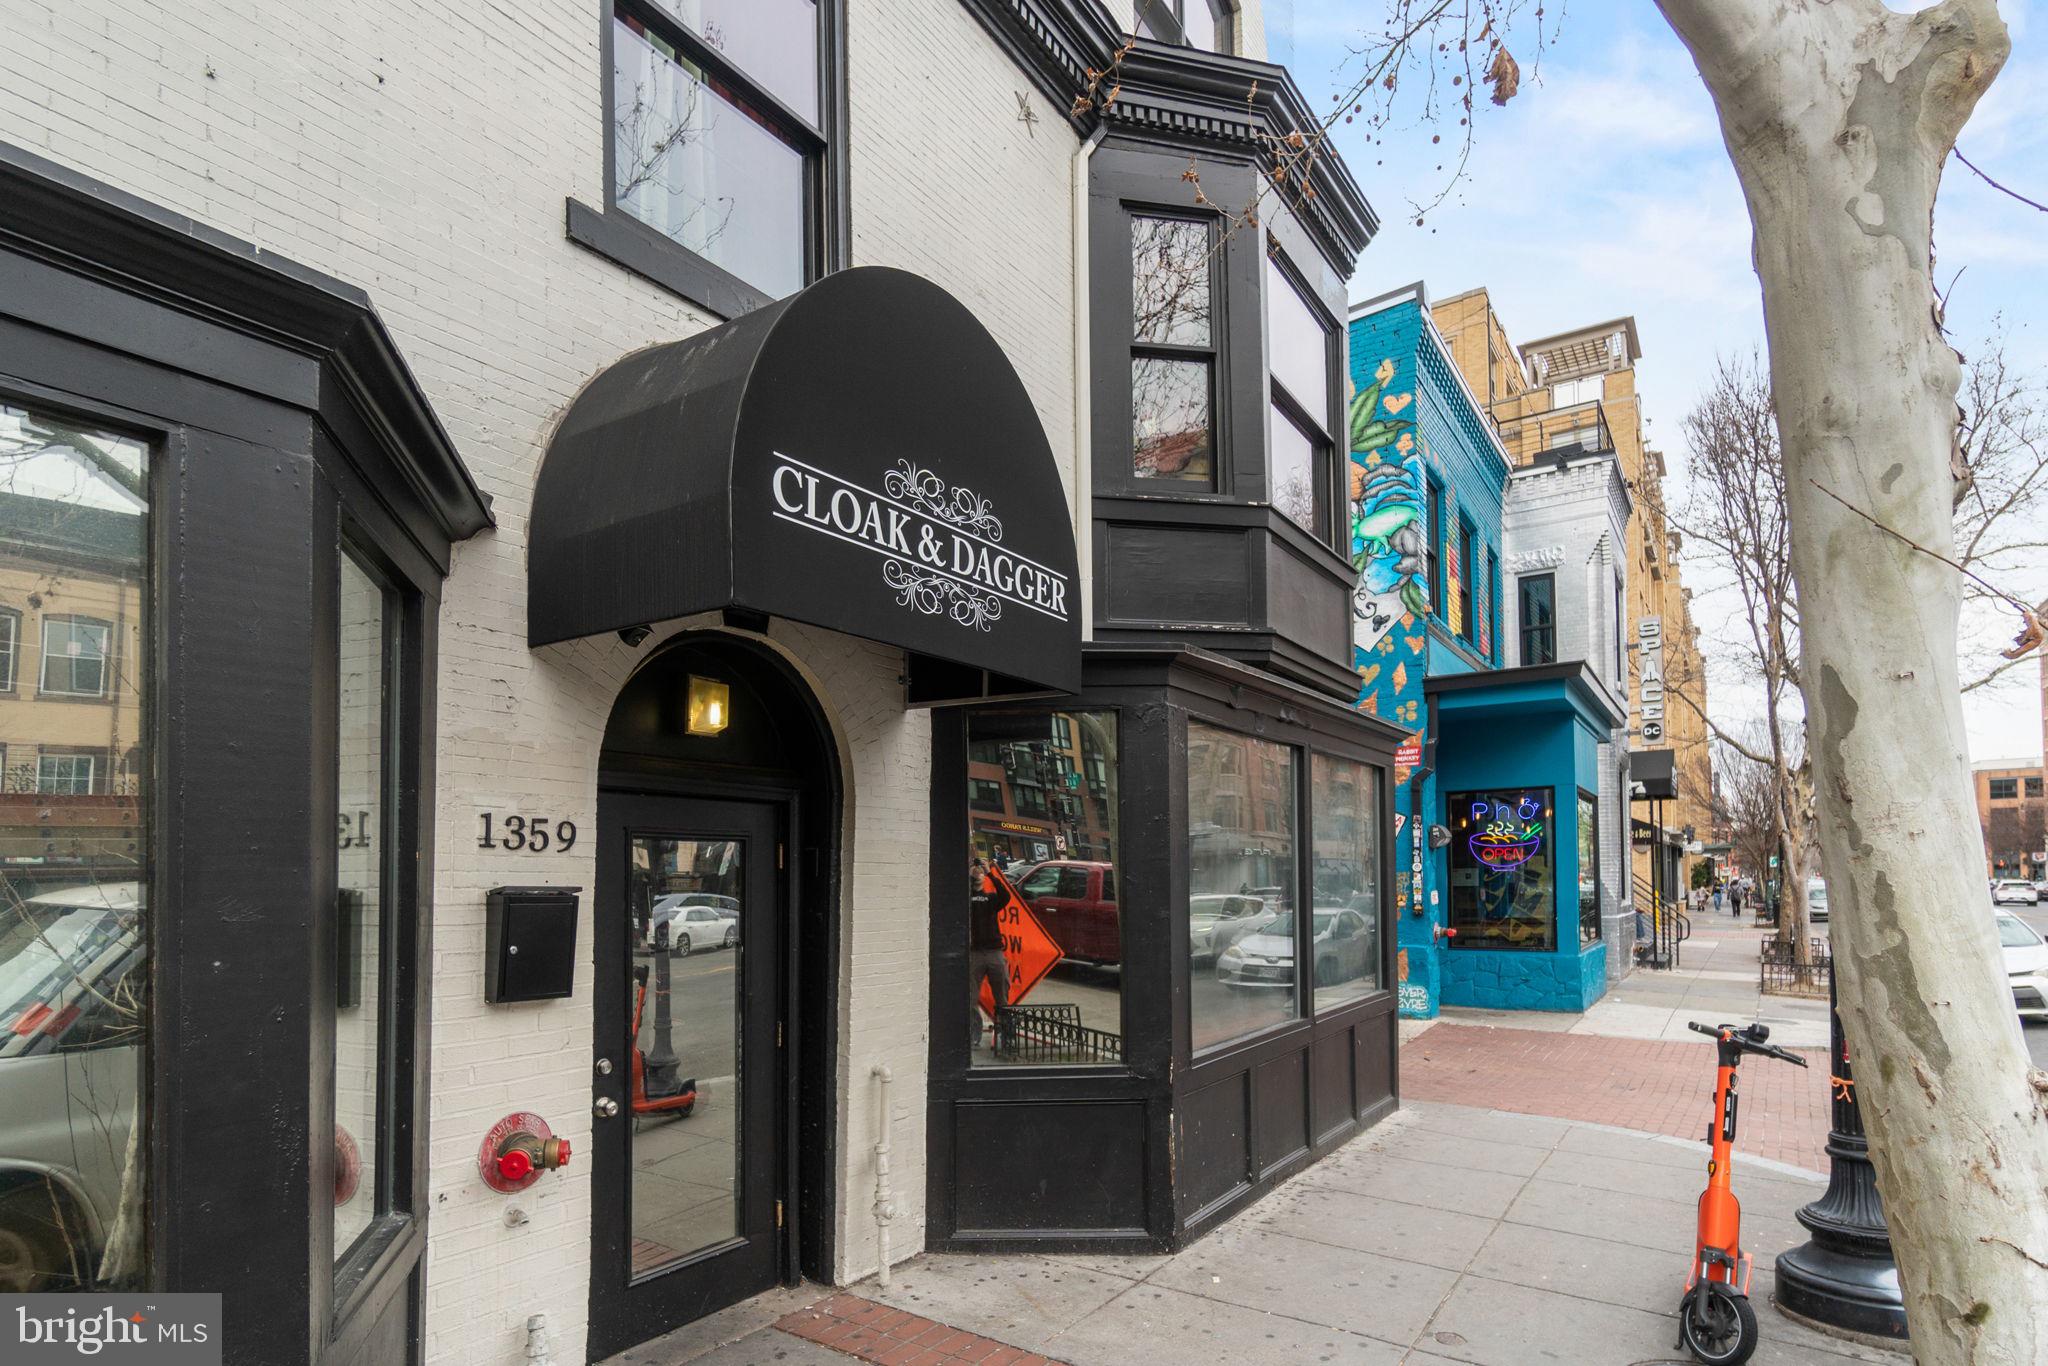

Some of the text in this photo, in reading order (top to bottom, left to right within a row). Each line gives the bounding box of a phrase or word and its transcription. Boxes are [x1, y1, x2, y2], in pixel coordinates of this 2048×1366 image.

[773, 465, 1068, 615] CLOAK & DAGGER
[1643, 726, 1661, 736] DC
[478, 812, 577, 853] 1359
[1482, 847, 1524, 861] OPEN
[489, 1119, 513, 1145] AUTO
